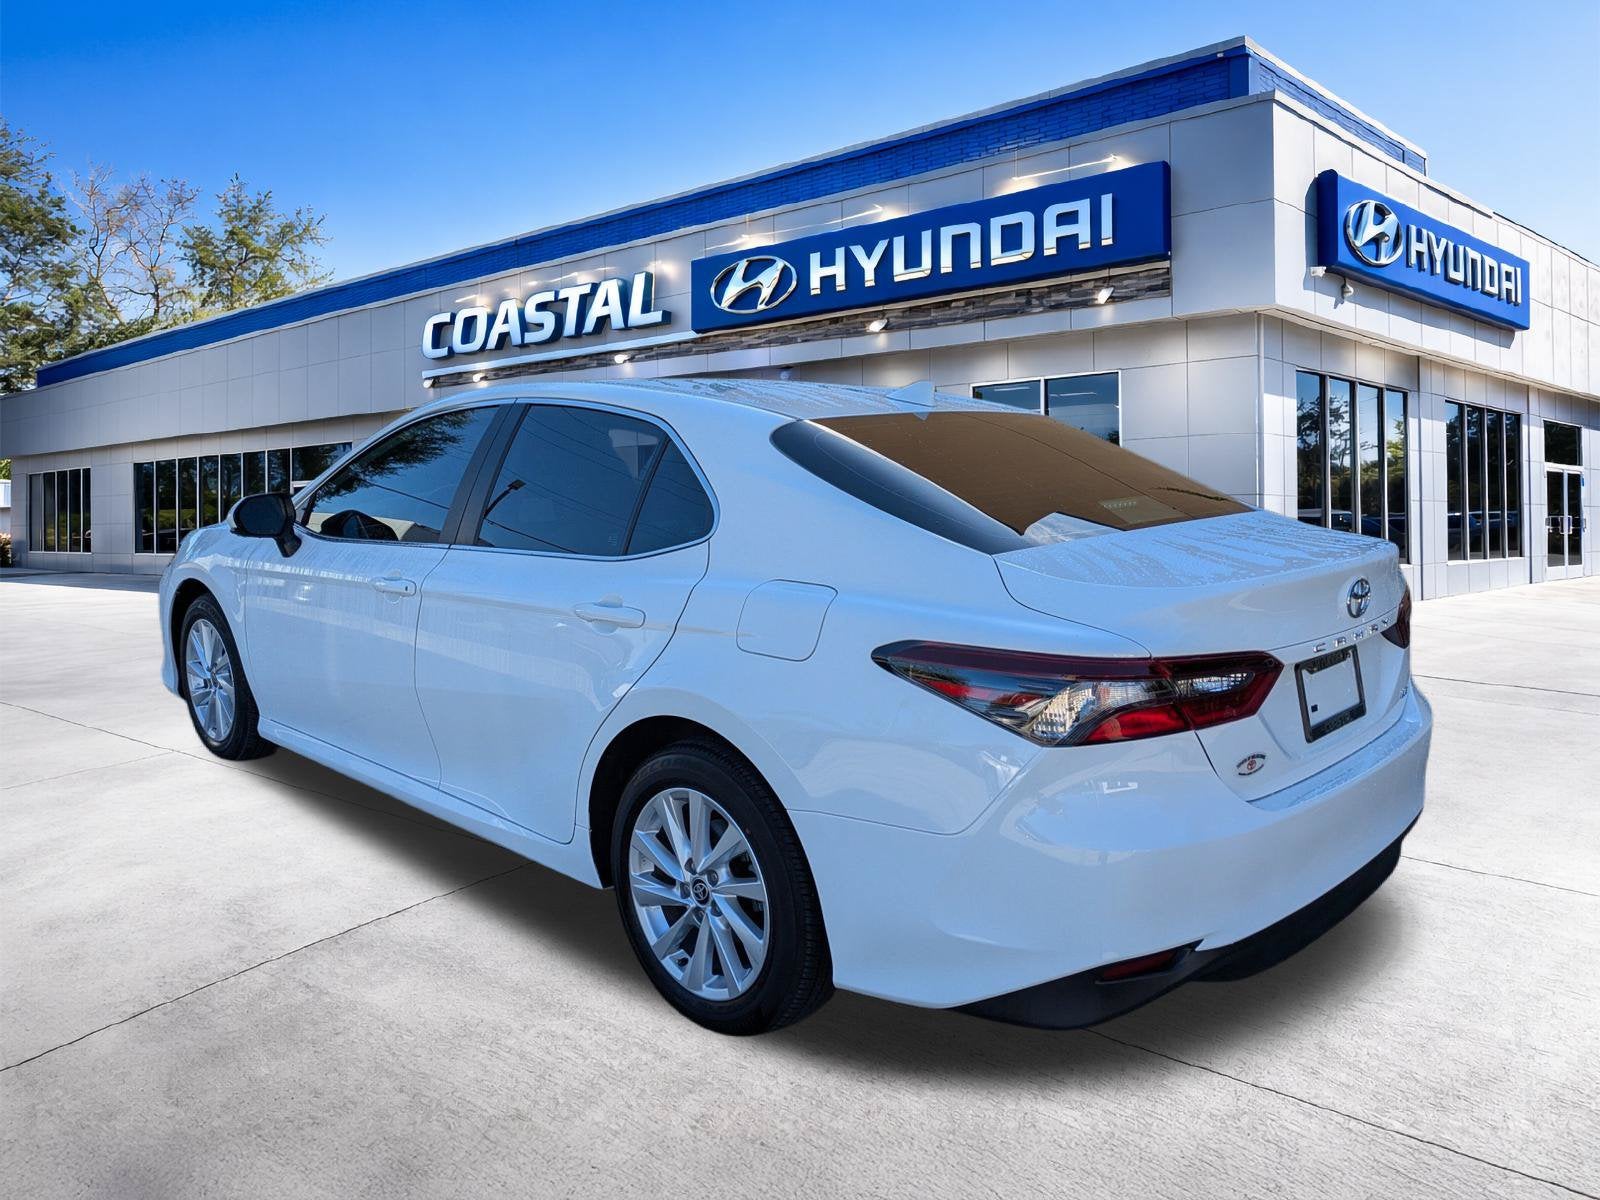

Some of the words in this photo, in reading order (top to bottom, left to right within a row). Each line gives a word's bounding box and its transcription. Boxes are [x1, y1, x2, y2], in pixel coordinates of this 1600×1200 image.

[809, 193, 1114, 296] HYUNDAI
[1406, 223, 1522, 306] HYUNDAI
[422, 271, 670, 360] COASTAL
[1312, 617, 1391, 654] CAMRY
